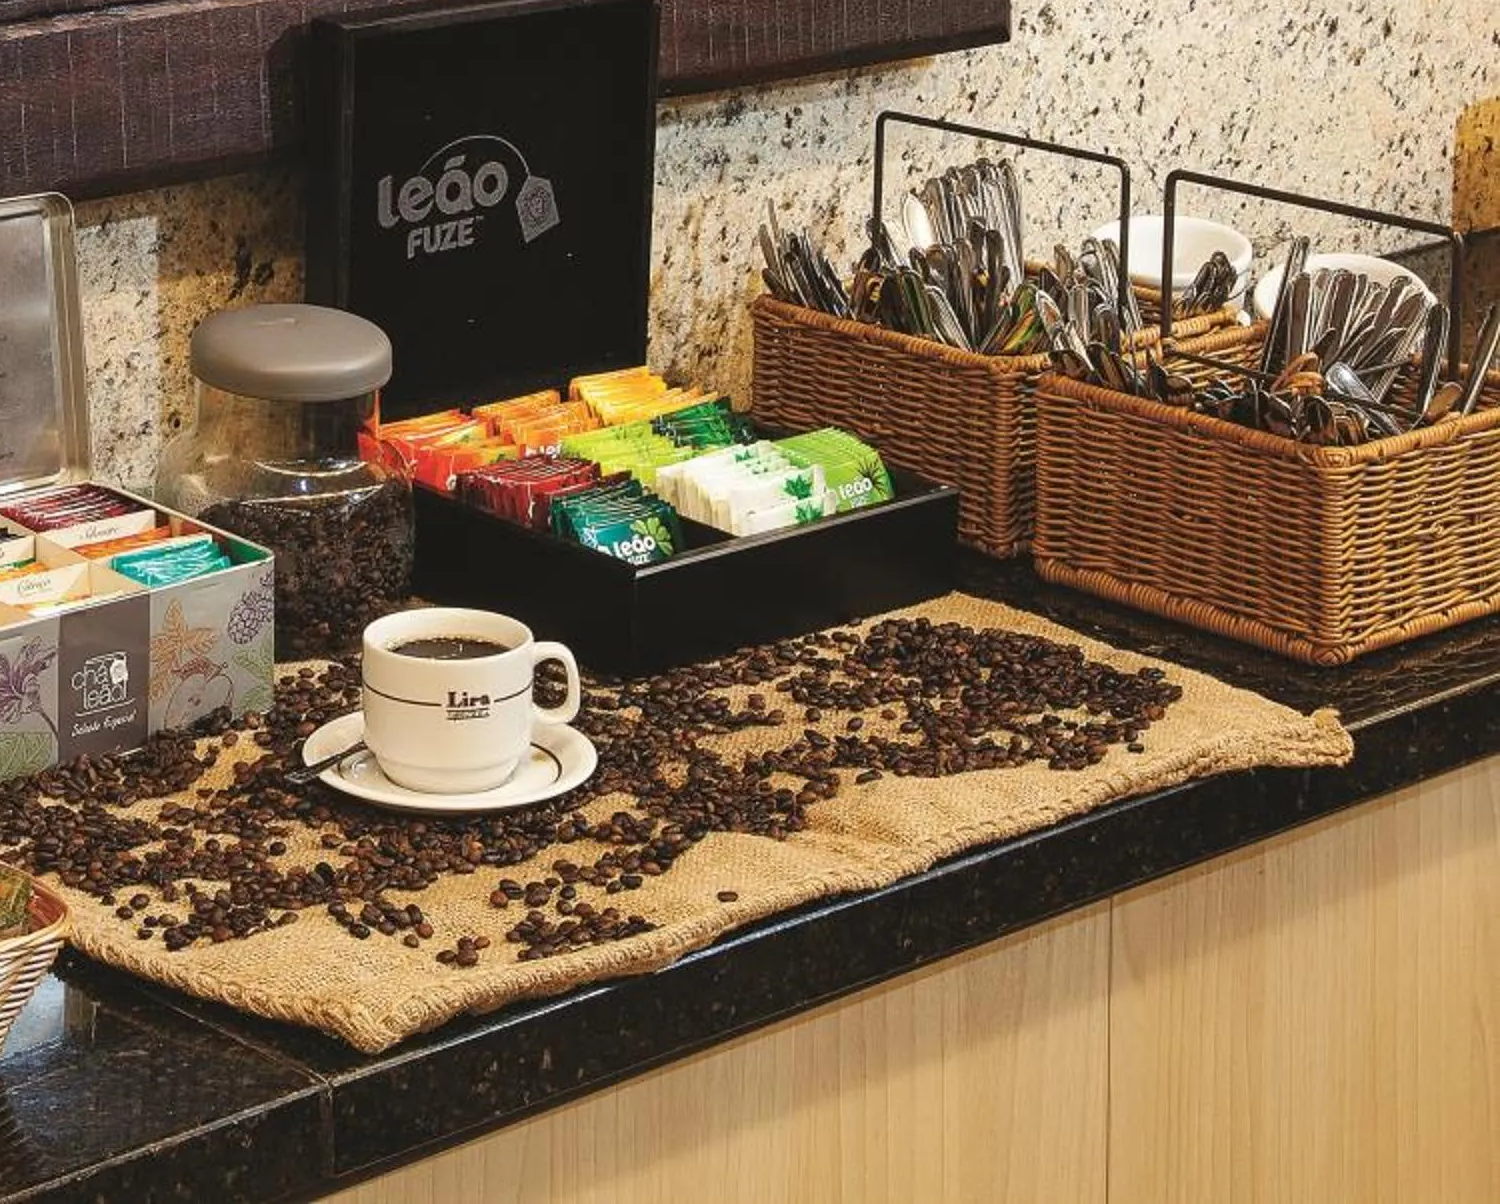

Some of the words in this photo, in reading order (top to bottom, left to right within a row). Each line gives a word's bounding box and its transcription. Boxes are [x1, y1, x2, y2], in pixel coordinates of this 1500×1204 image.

[377, 155, 509, 229] leão
[406, 218, 476, 260] FUZE
[445, 691, 490, 708] Lira
